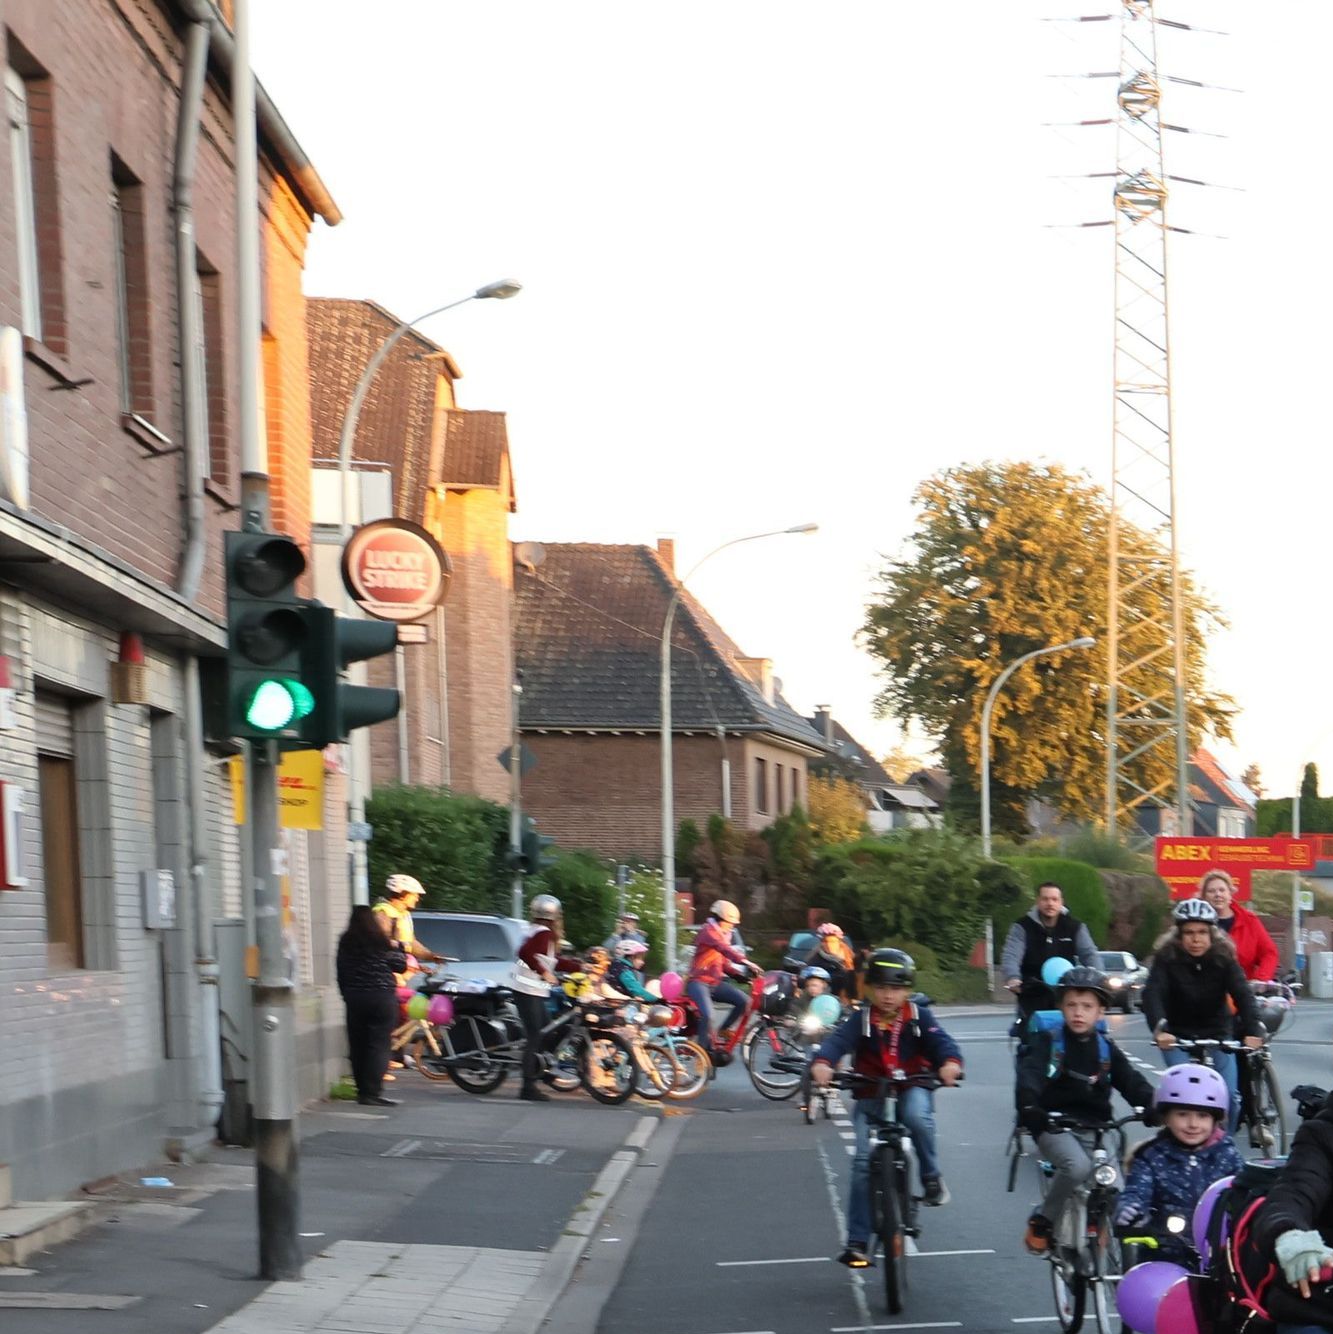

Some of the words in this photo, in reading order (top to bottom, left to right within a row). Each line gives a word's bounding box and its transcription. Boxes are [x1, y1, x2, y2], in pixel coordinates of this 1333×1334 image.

[366, 549, 424, 570] LUCKY
[362, 567, 428, 589] STRIKE
[1162, 845, 1212, 860] ABEX
